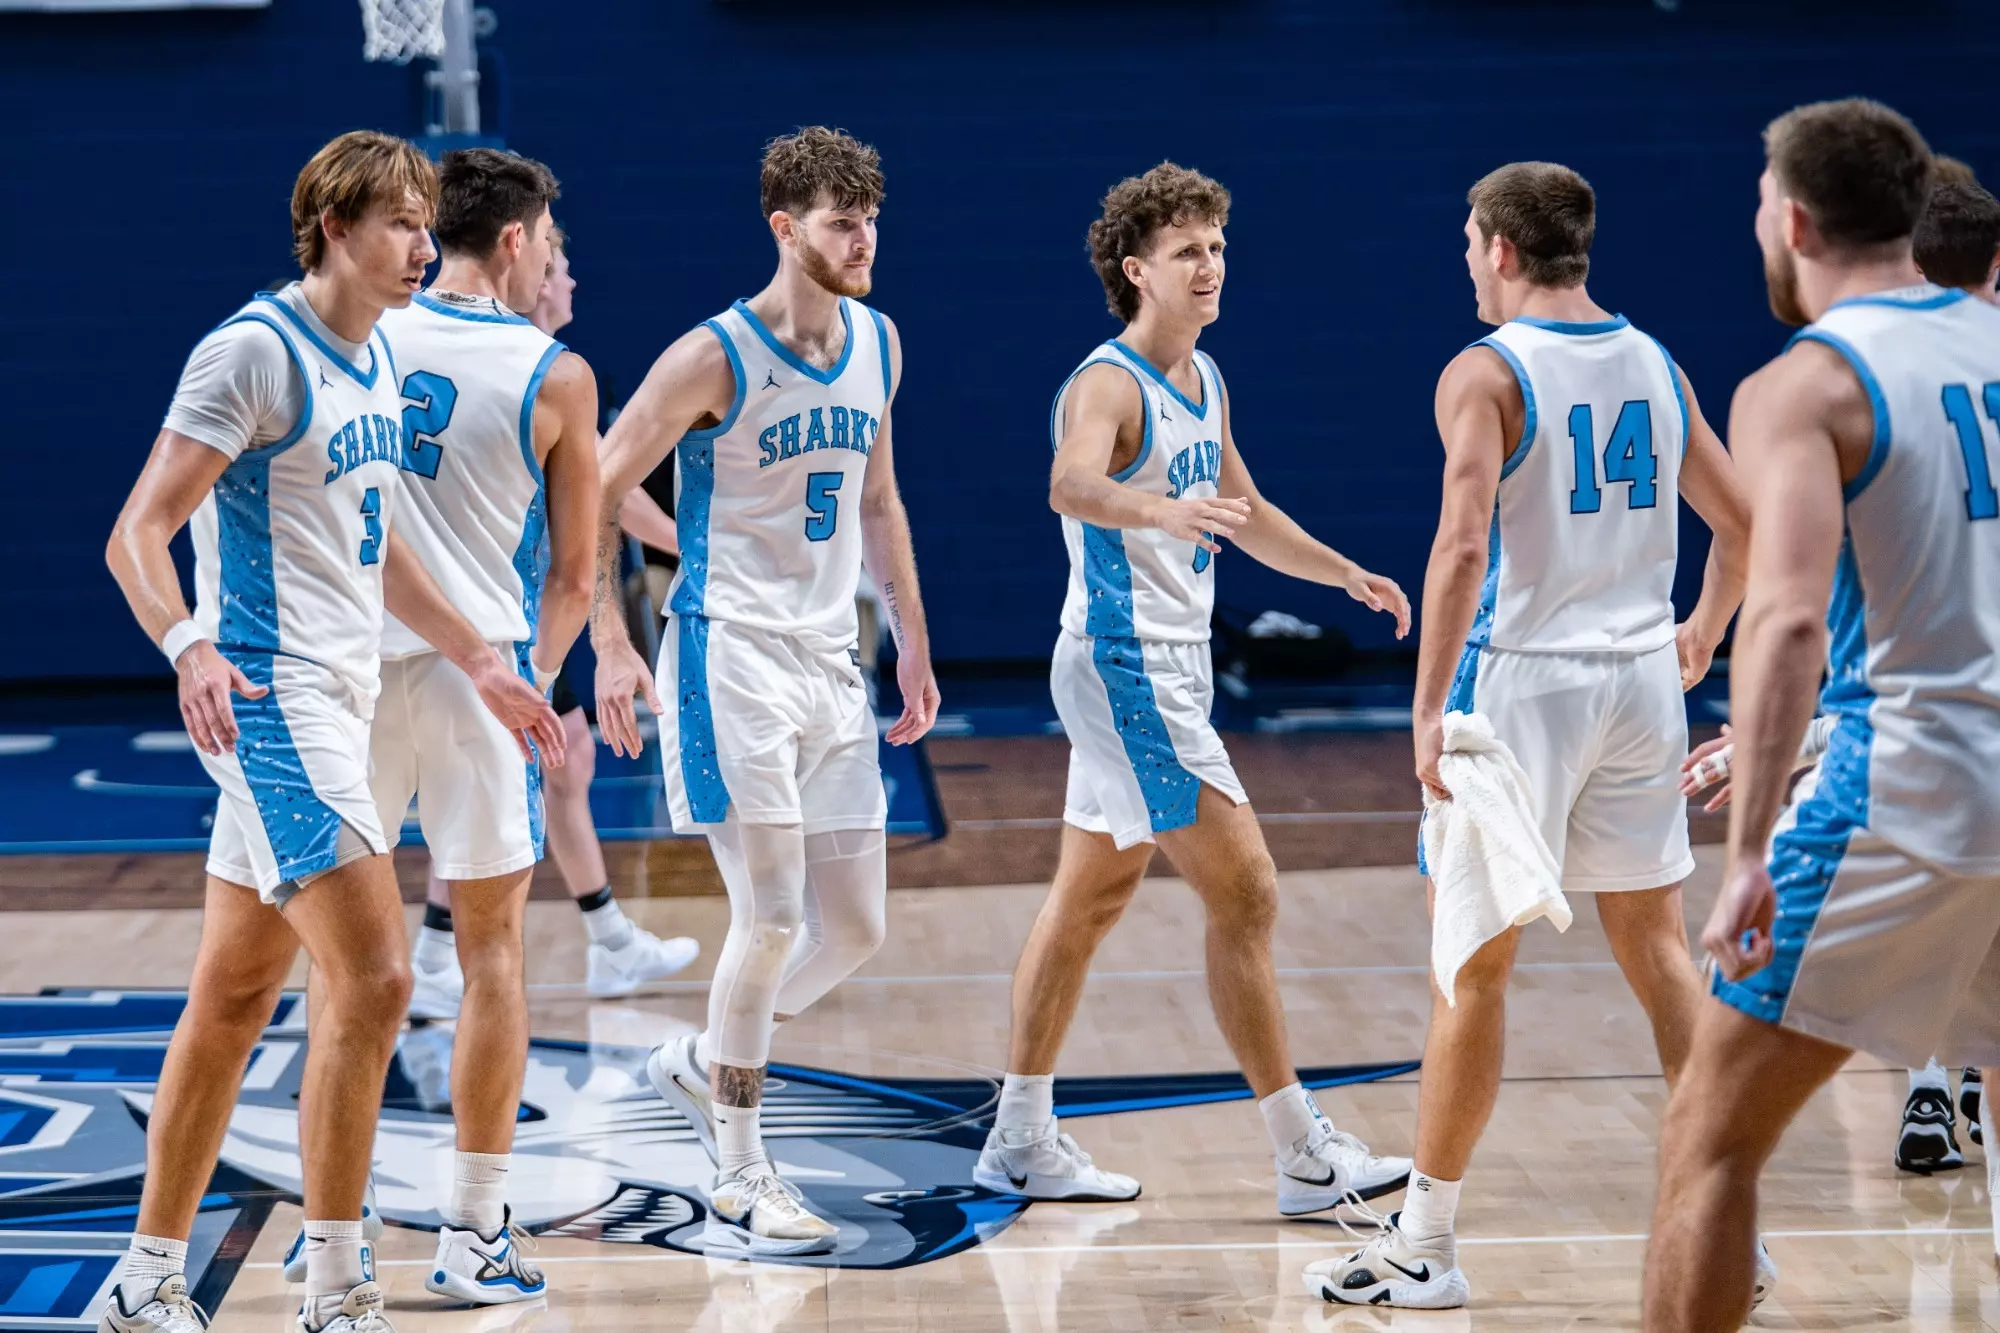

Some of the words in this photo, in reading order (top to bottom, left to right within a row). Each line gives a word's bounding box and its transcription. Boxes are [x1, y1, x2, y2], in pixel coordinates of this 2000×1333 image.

[324, 413, 403, 485] SHARK
[401, 370, 458, 480] 2
[1568, 400, 1657, 514] 14
[1941, 382, 2000, 520] 1
[360, 487, 383, 566] 3
[805, 472, 844, 542] 5
